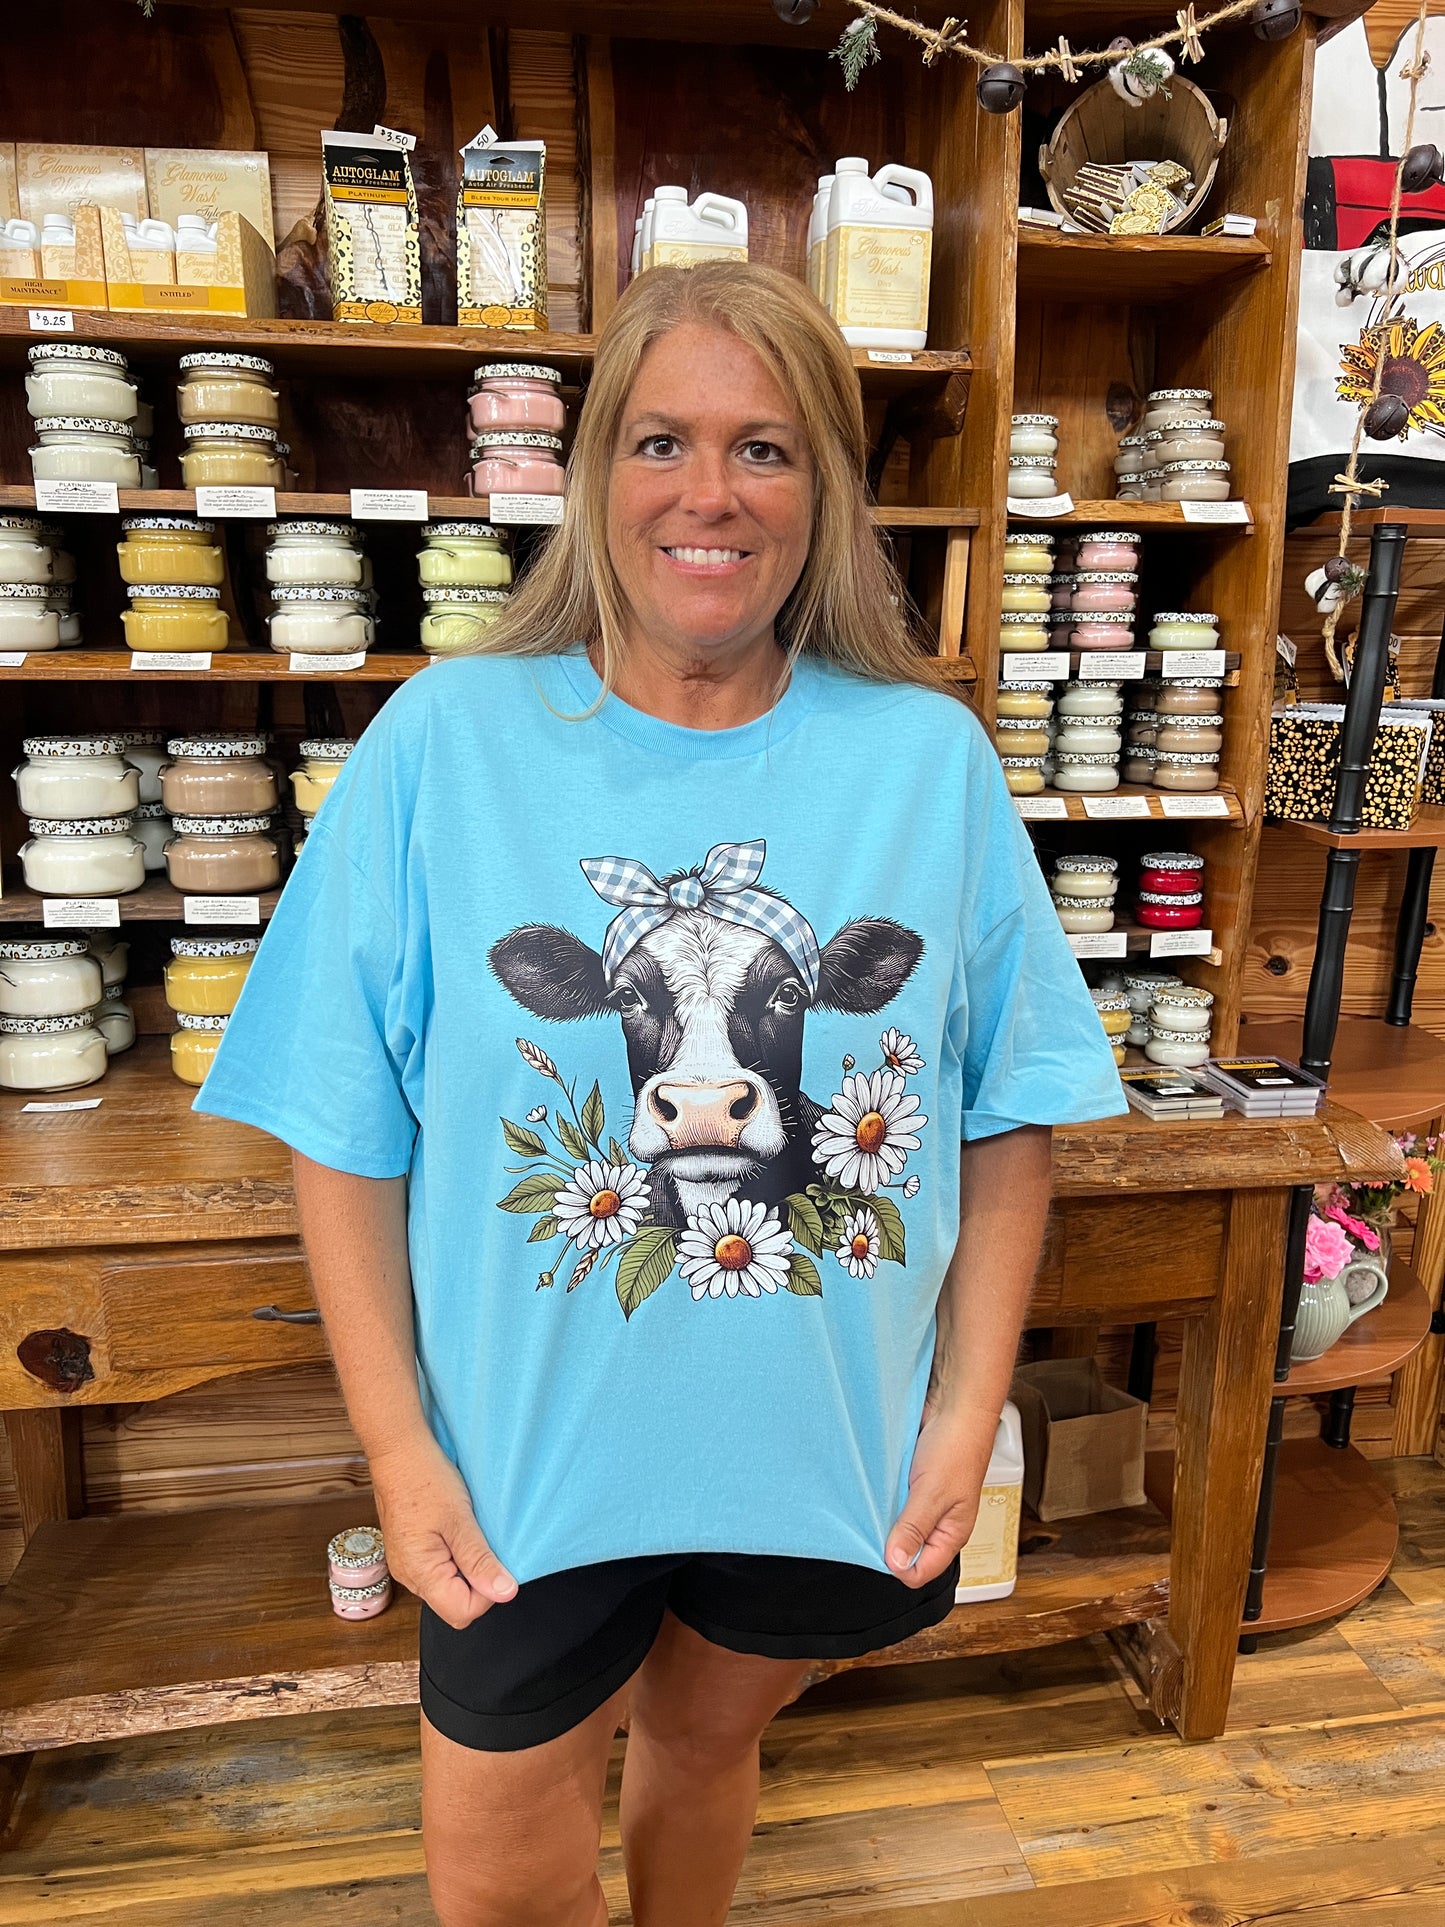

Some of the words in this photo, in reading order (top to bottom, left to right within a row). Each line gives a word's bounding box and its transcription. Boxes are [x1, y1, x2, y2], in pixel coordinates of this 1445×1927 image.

[380, 129, 408, 146] $3.50
[32, 155, 102, 178] Glamorous
[161, 162, 228, 187] Glamorous
[332, 165, 401, 182] AUTOGLAM
[364, 179, 401, 187] Freshener
[467, 168, 534, 184] AUTOGLAM
[180, 184, 219, 203] Wash
[196, 205, 222, 220] Tyle
[851, 235, 912, 260] Glamorous
[868, 257, 901, 275] Wash
[11, 287, 58, 295] MAINTENANCE
[36, 313, 67, 326] $8.25
